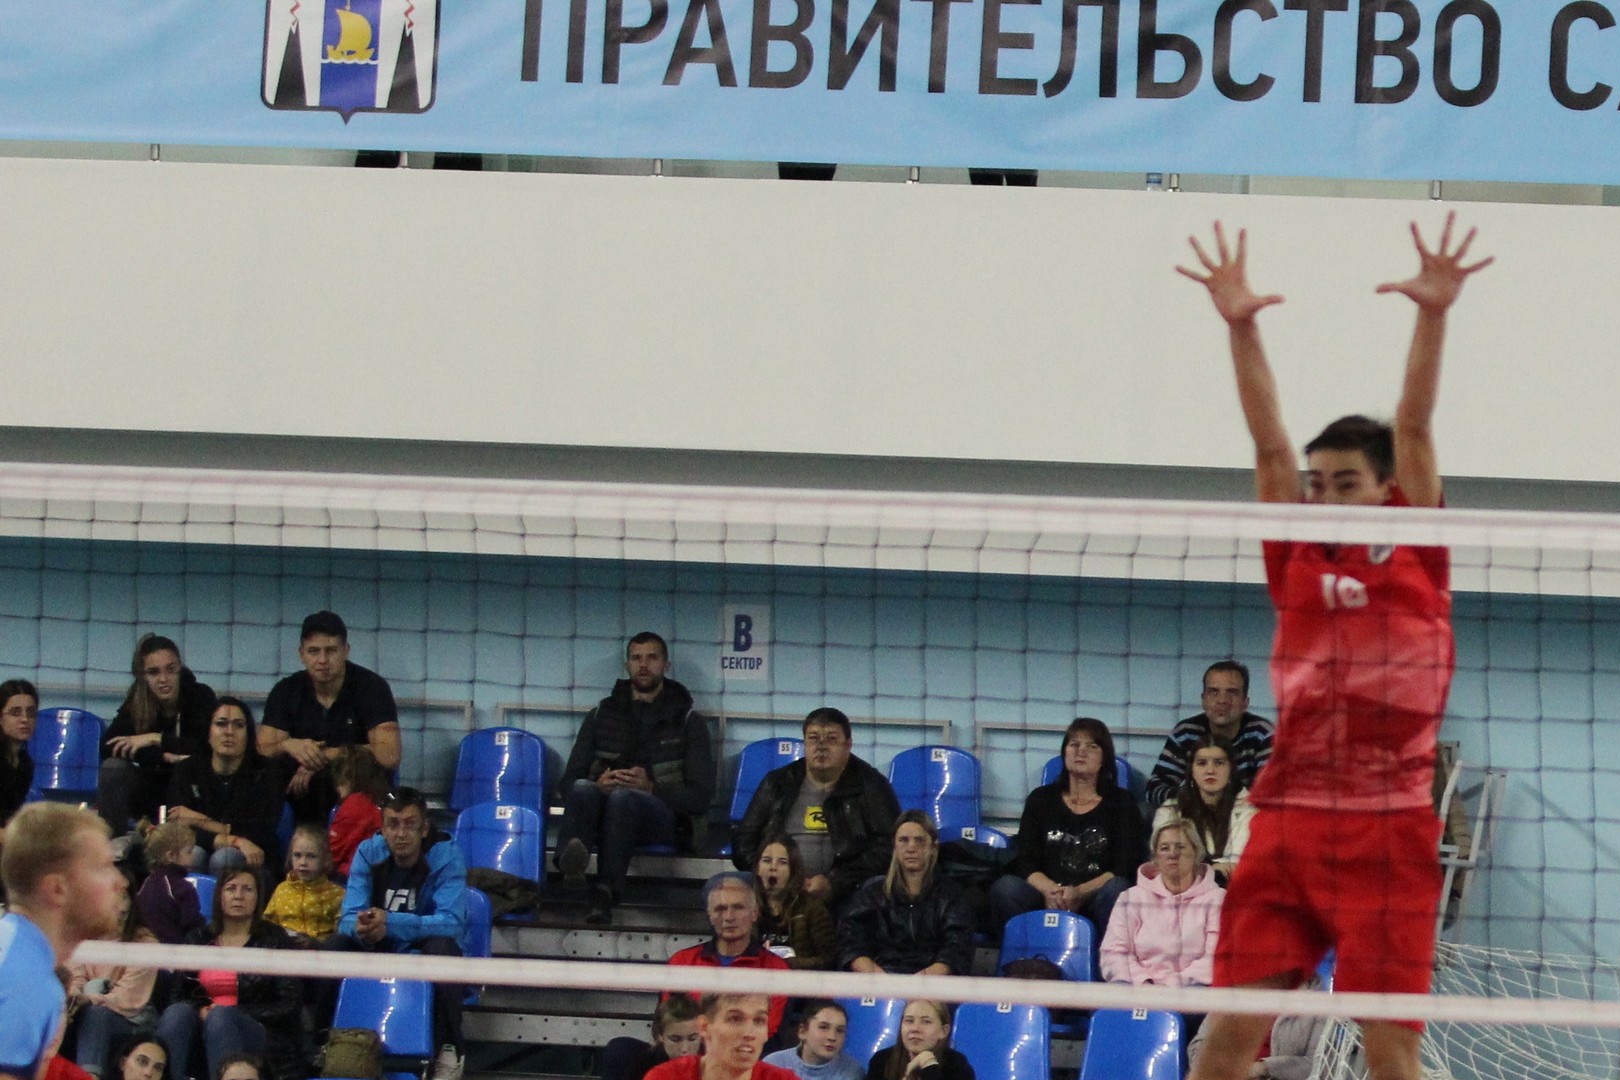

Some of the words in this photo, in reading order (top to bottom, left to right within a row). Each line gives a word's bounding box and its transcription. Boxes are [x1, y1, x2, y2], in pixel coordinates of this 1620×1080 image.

[520, 0, 1502, 108] ПРАВИТЕЛЬСТВО
[733, 613, 753, 653] В
[721, 656, 763, 671] СЕКТОР
